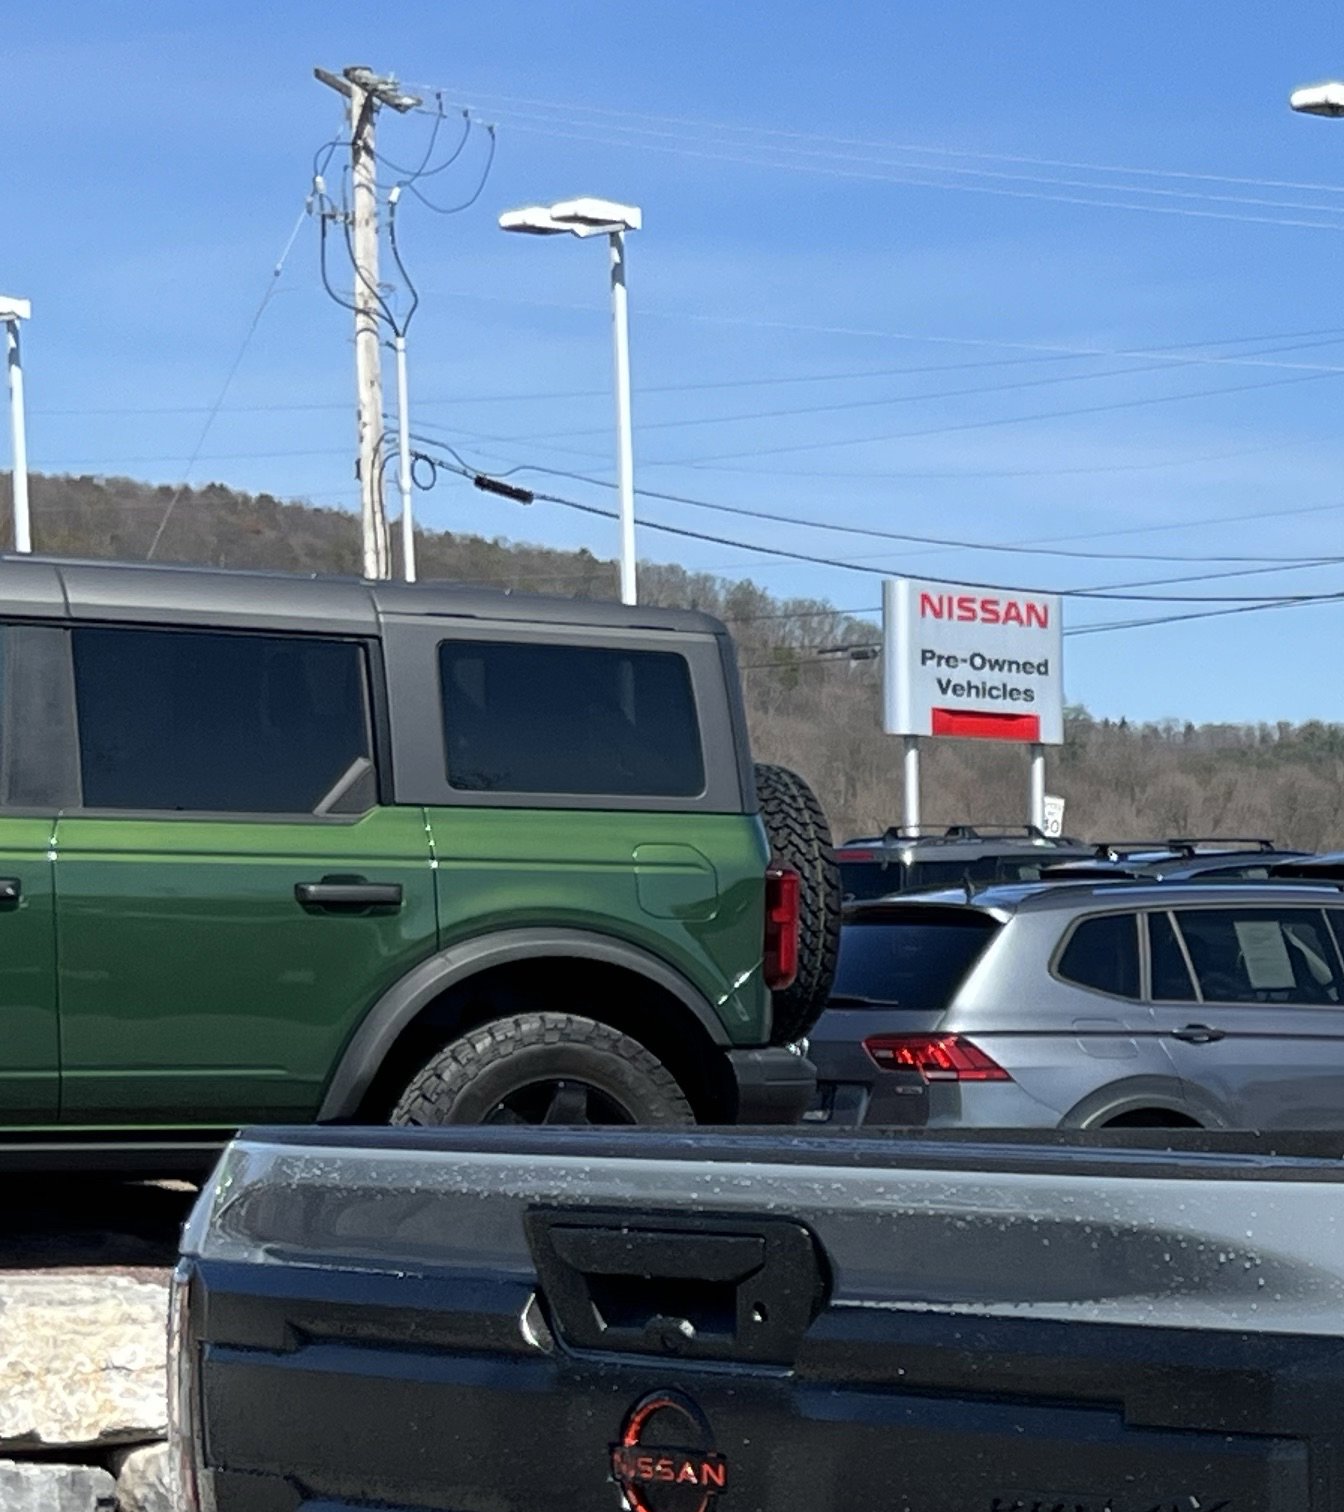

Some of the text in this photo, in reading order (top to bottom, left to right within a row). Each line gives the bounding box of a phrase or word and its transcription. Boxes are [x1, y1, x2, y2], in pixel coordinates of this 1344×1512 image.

[919, 591, 1049, 629] NISSAN
[920, 648, 1050, 676] Pre-Owned
[936, 677, 1036, 702] Vehicles
